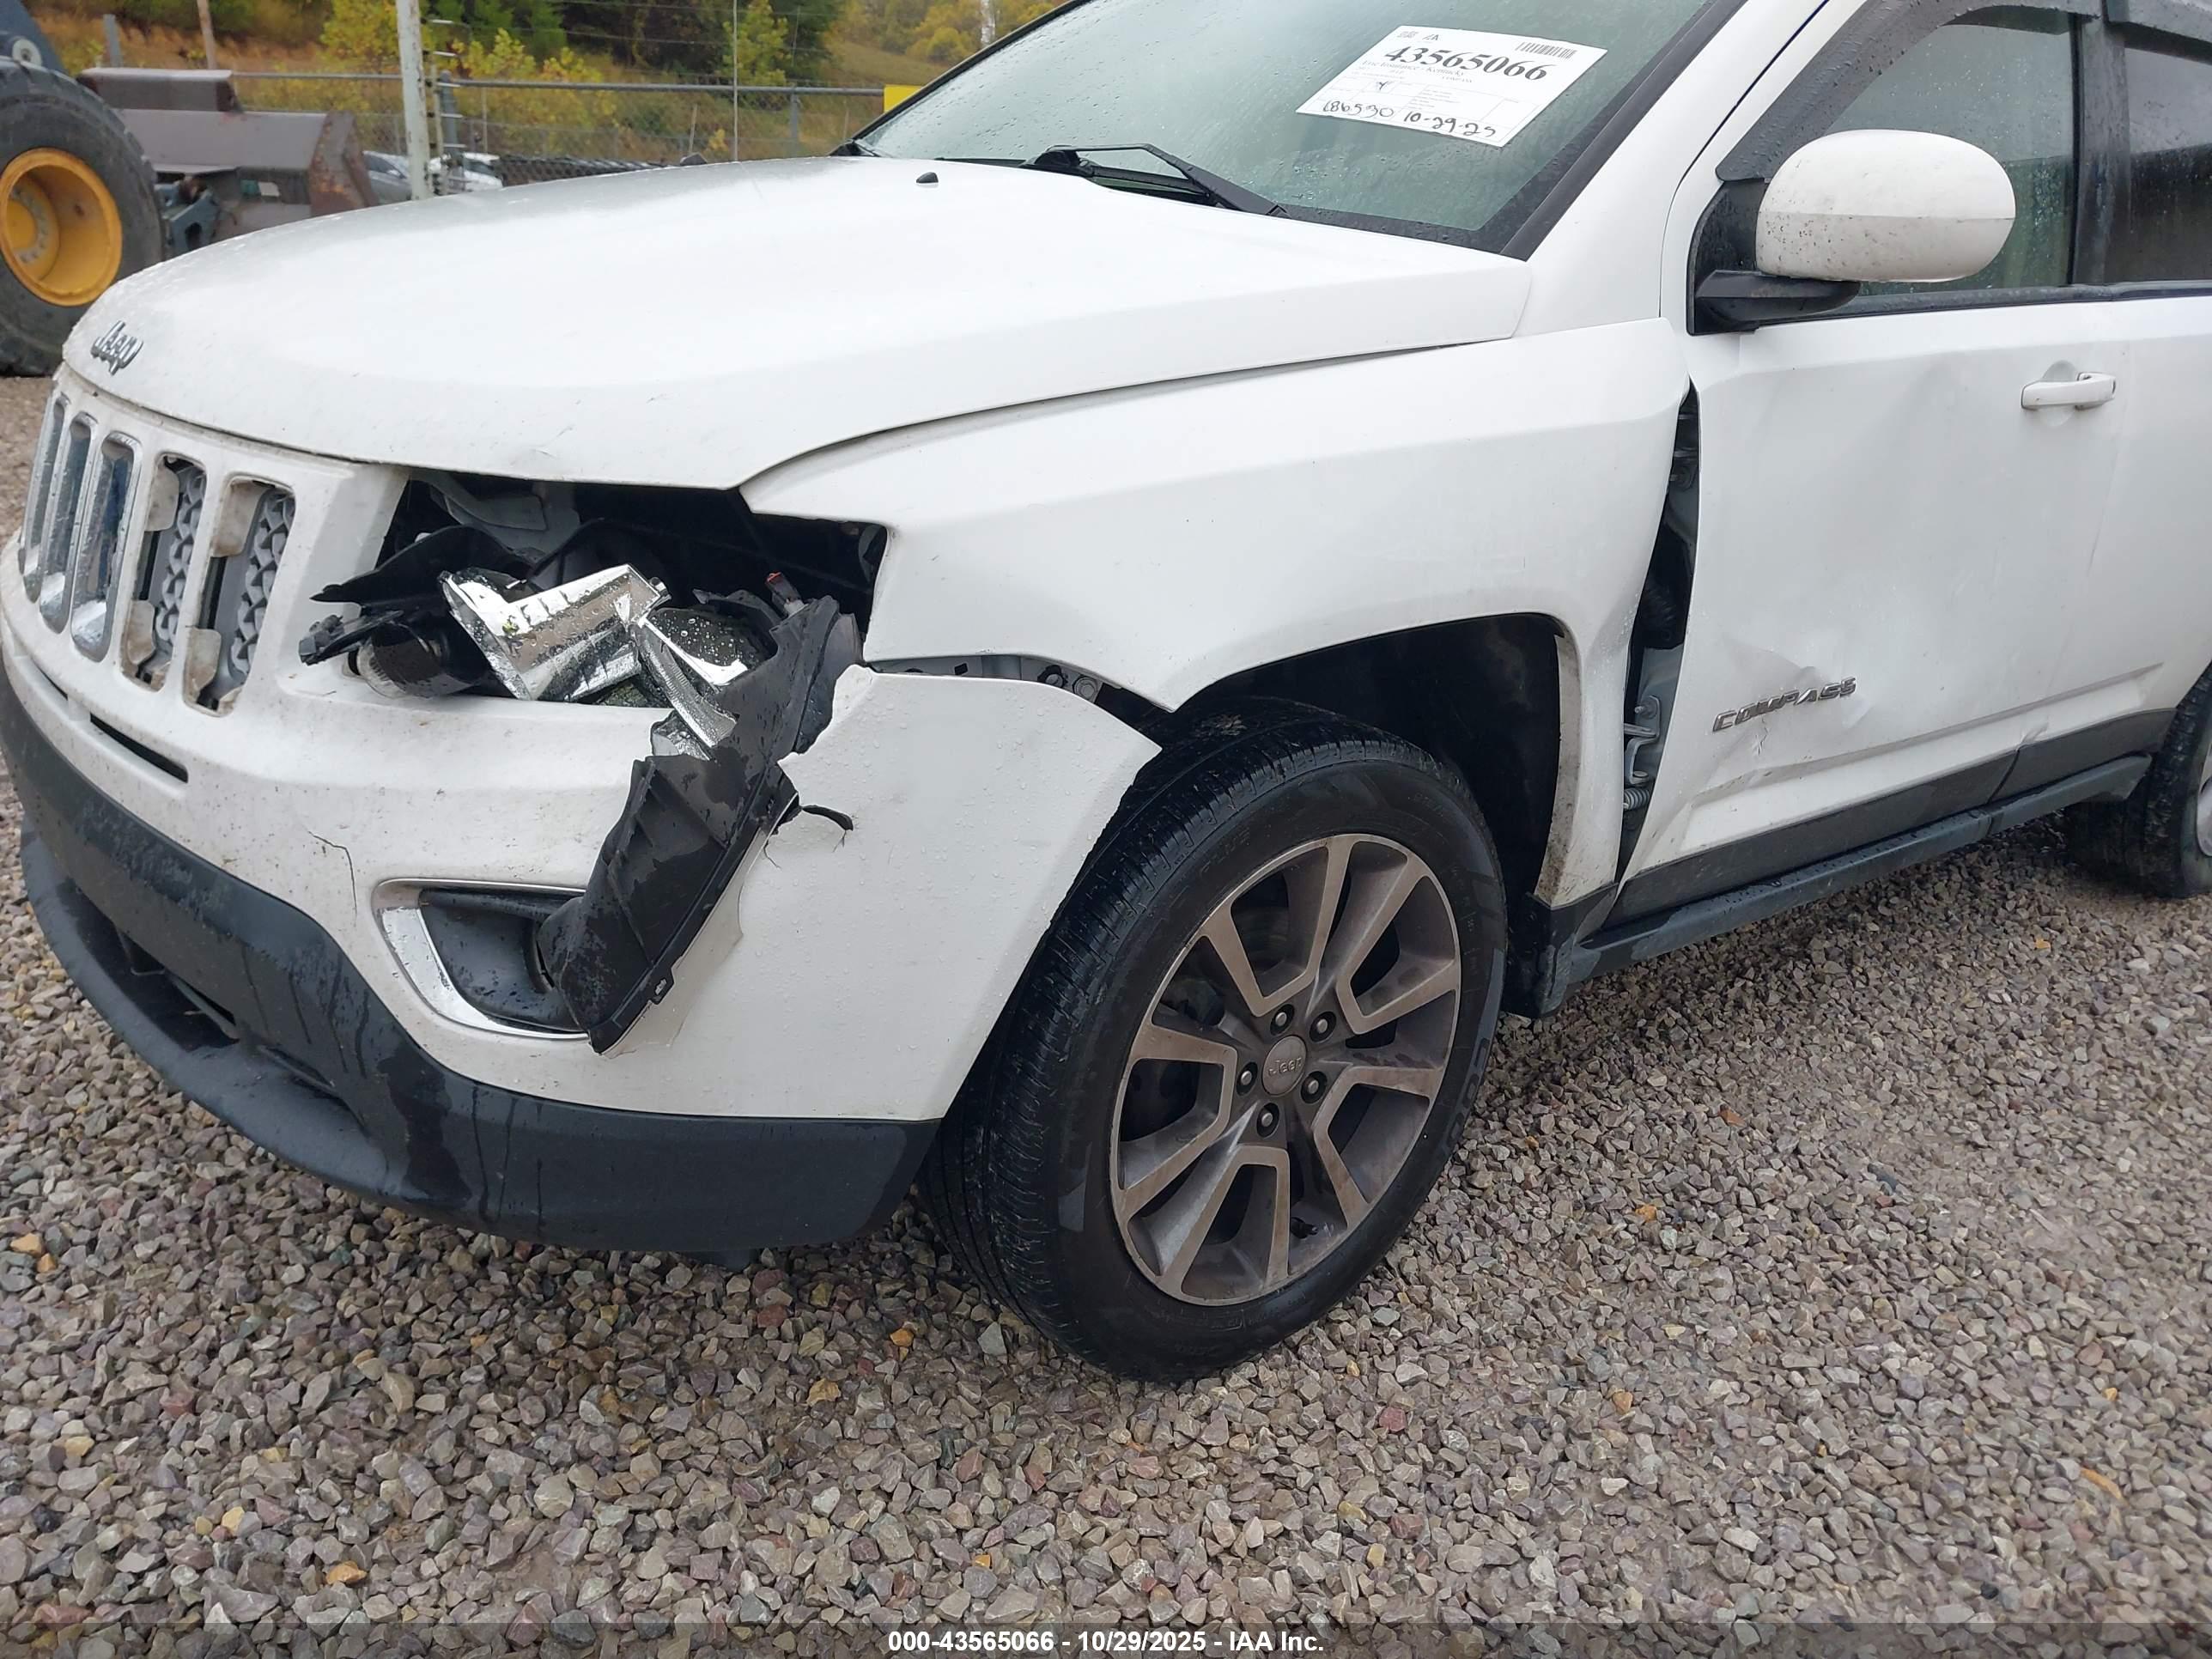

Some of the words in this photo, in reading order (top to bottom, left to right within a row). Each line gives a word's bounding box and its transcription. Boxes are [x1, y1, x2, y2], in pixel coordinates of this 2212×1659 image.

[1384, 46, 1558, 81] 43565066
[90, 320, 144, 376] Jeep
[1712, 677, 1856, 732] COMPASS
